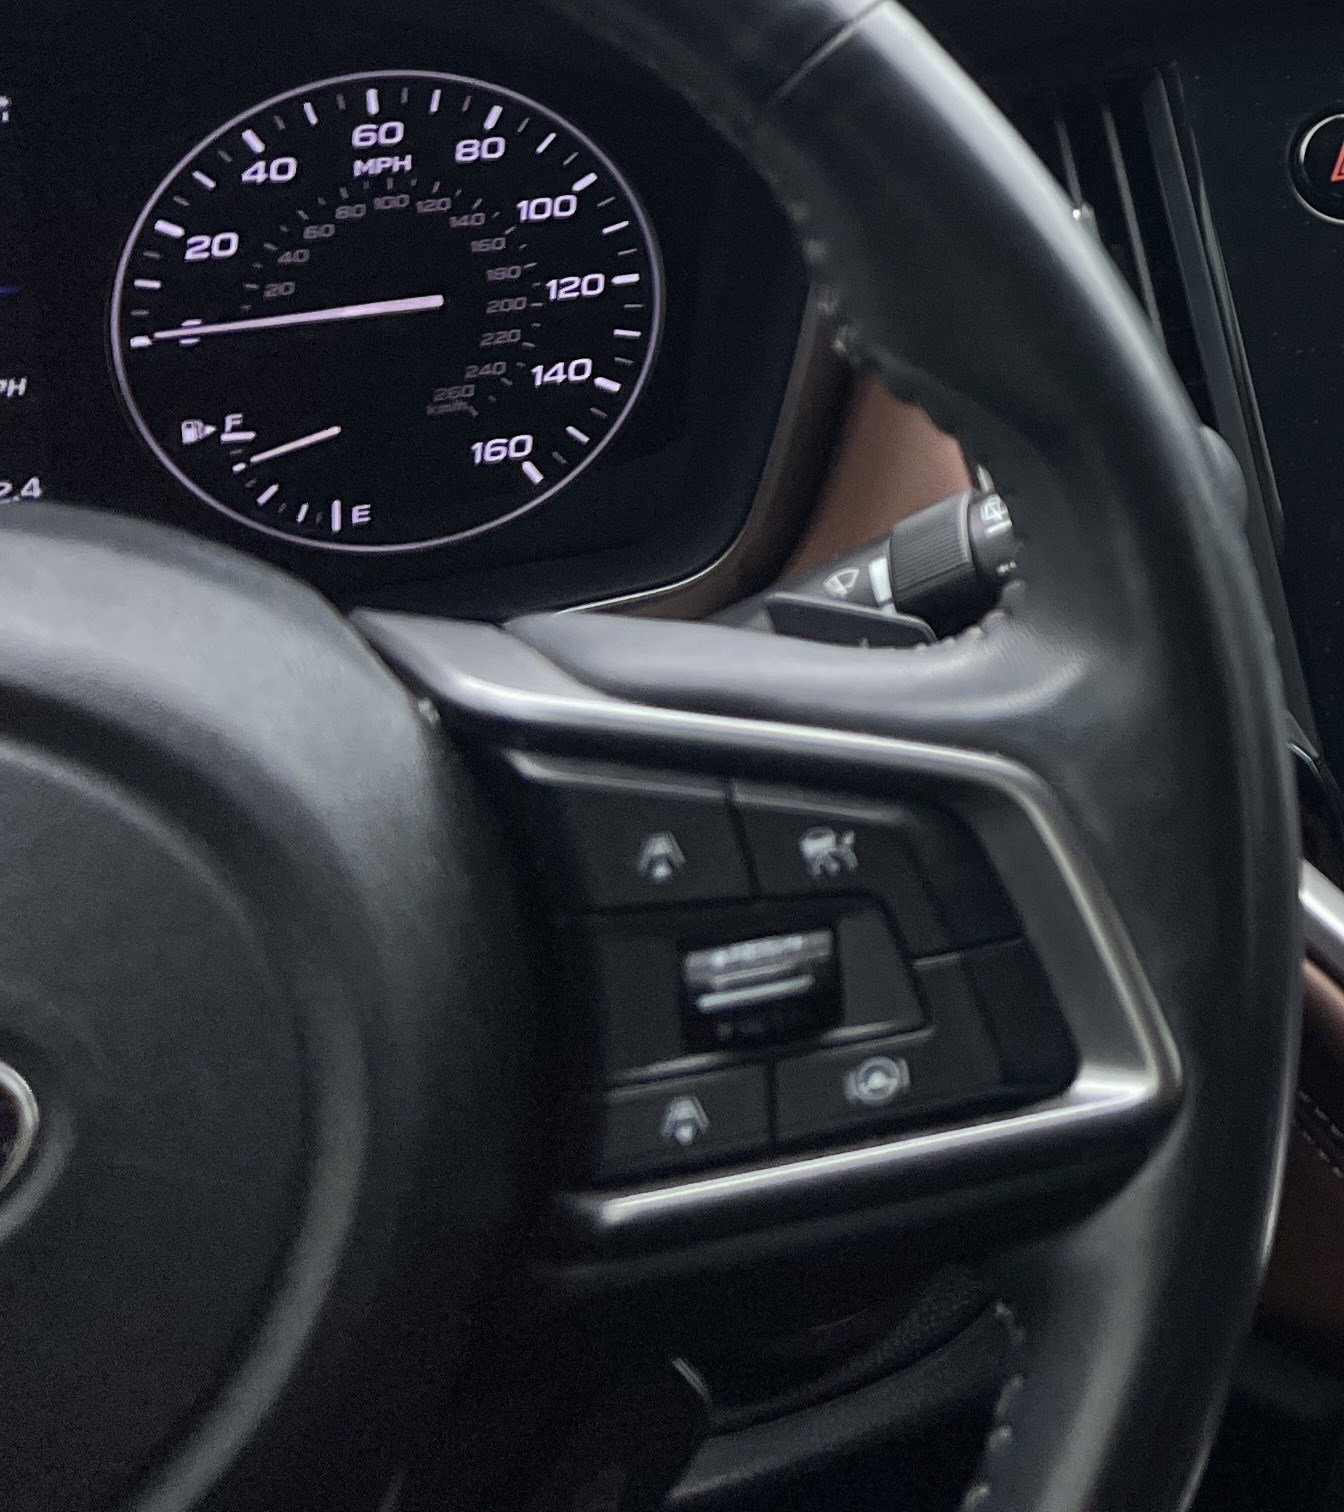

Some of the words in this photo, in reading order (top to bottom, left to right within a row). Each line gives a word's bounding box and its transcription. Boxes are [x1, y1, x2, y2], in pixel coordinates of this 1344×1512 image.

[351, 121, 405, 150] 60
[454, 136, 506, 164] 80
[241, 156, 298, 184] 40
[353, 154, 412, 178] MPH
[416, 197, 452, 213] 120
[516, 194, 578, 223] 100
[450, 212, 486, 228] 140
[184, 231, 240, 263] 20
[277, 248, 310, 264] 40
[263, 281, 295, 301] 20
[545, 273, 606, 302] 120
[486, 296, 527, 314] 200
[479, 329, 521, 349] 220
[464, 361, 507, 379] 240
[530, 358, 593, 388] 140
[224, 412, 244, 433] F
[470, 434, 534, 466] 160
[351, 504, 372, 525] E
